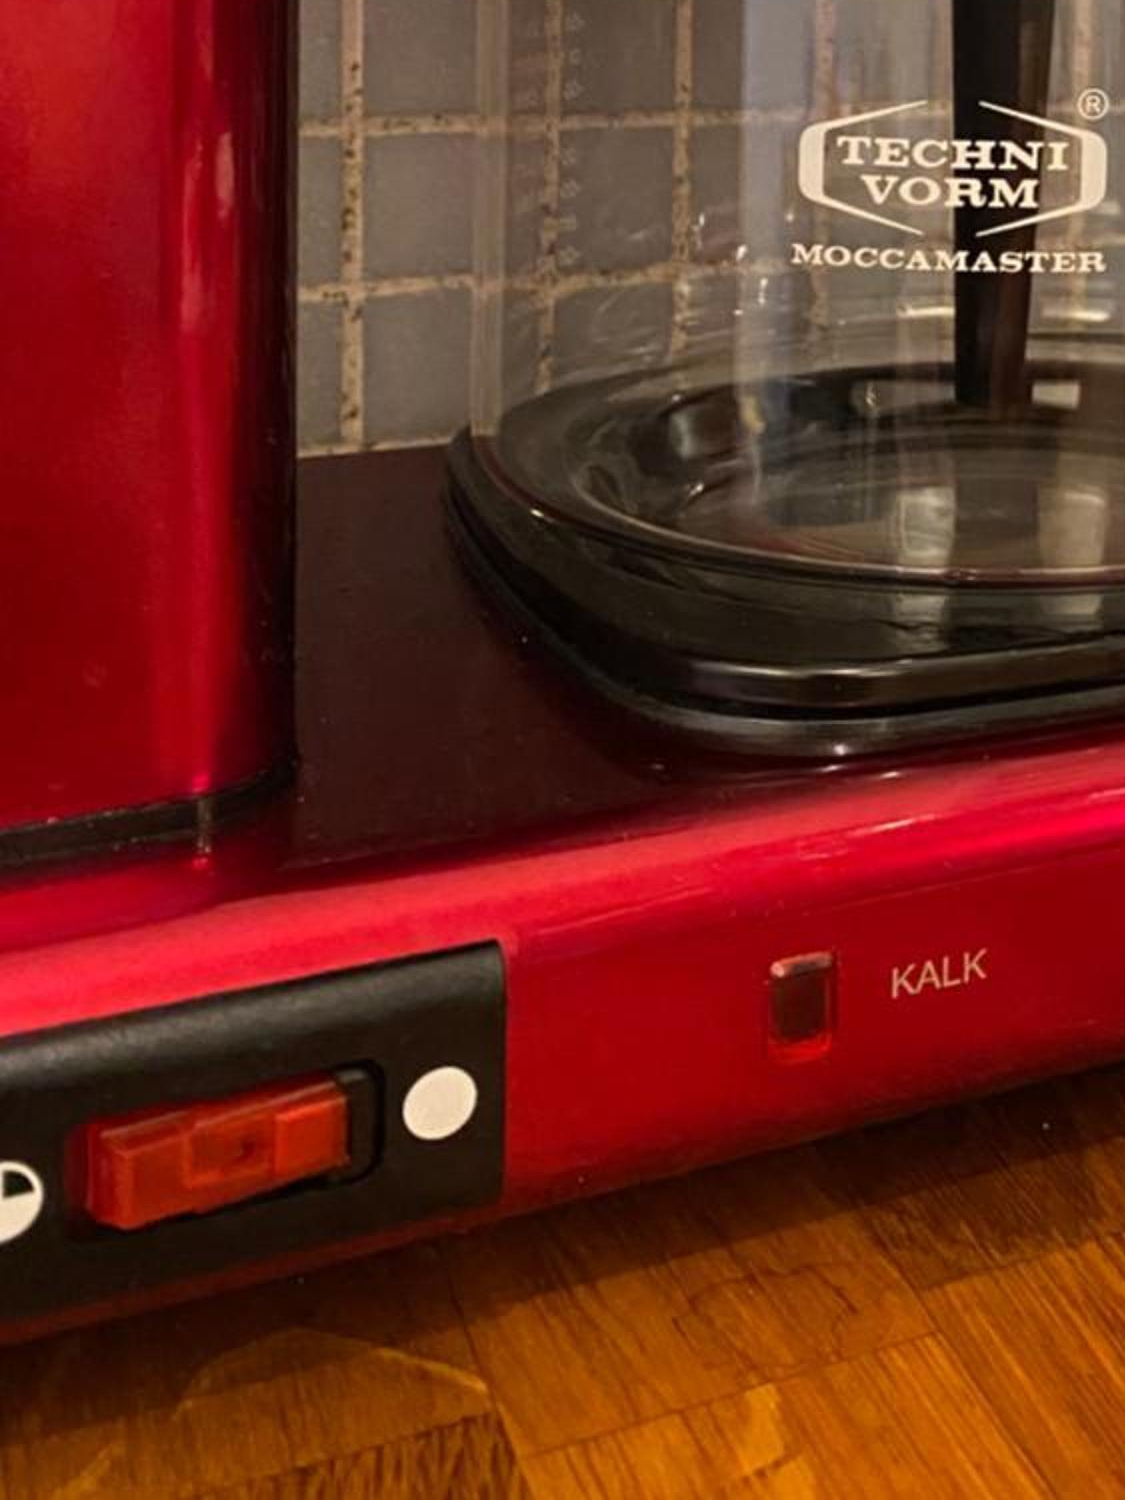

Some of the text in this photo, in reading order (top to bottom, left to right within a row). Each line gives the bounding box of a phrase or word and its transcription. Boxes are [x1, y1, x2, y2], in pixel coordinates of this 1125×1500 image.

[836, 135, 1070, 171] TECHNI
[860, 174, 1040, 209] VORM
[791, 243, 1107, 273] MOCCAMASTER
[891, 948, 988, 999] KALK
